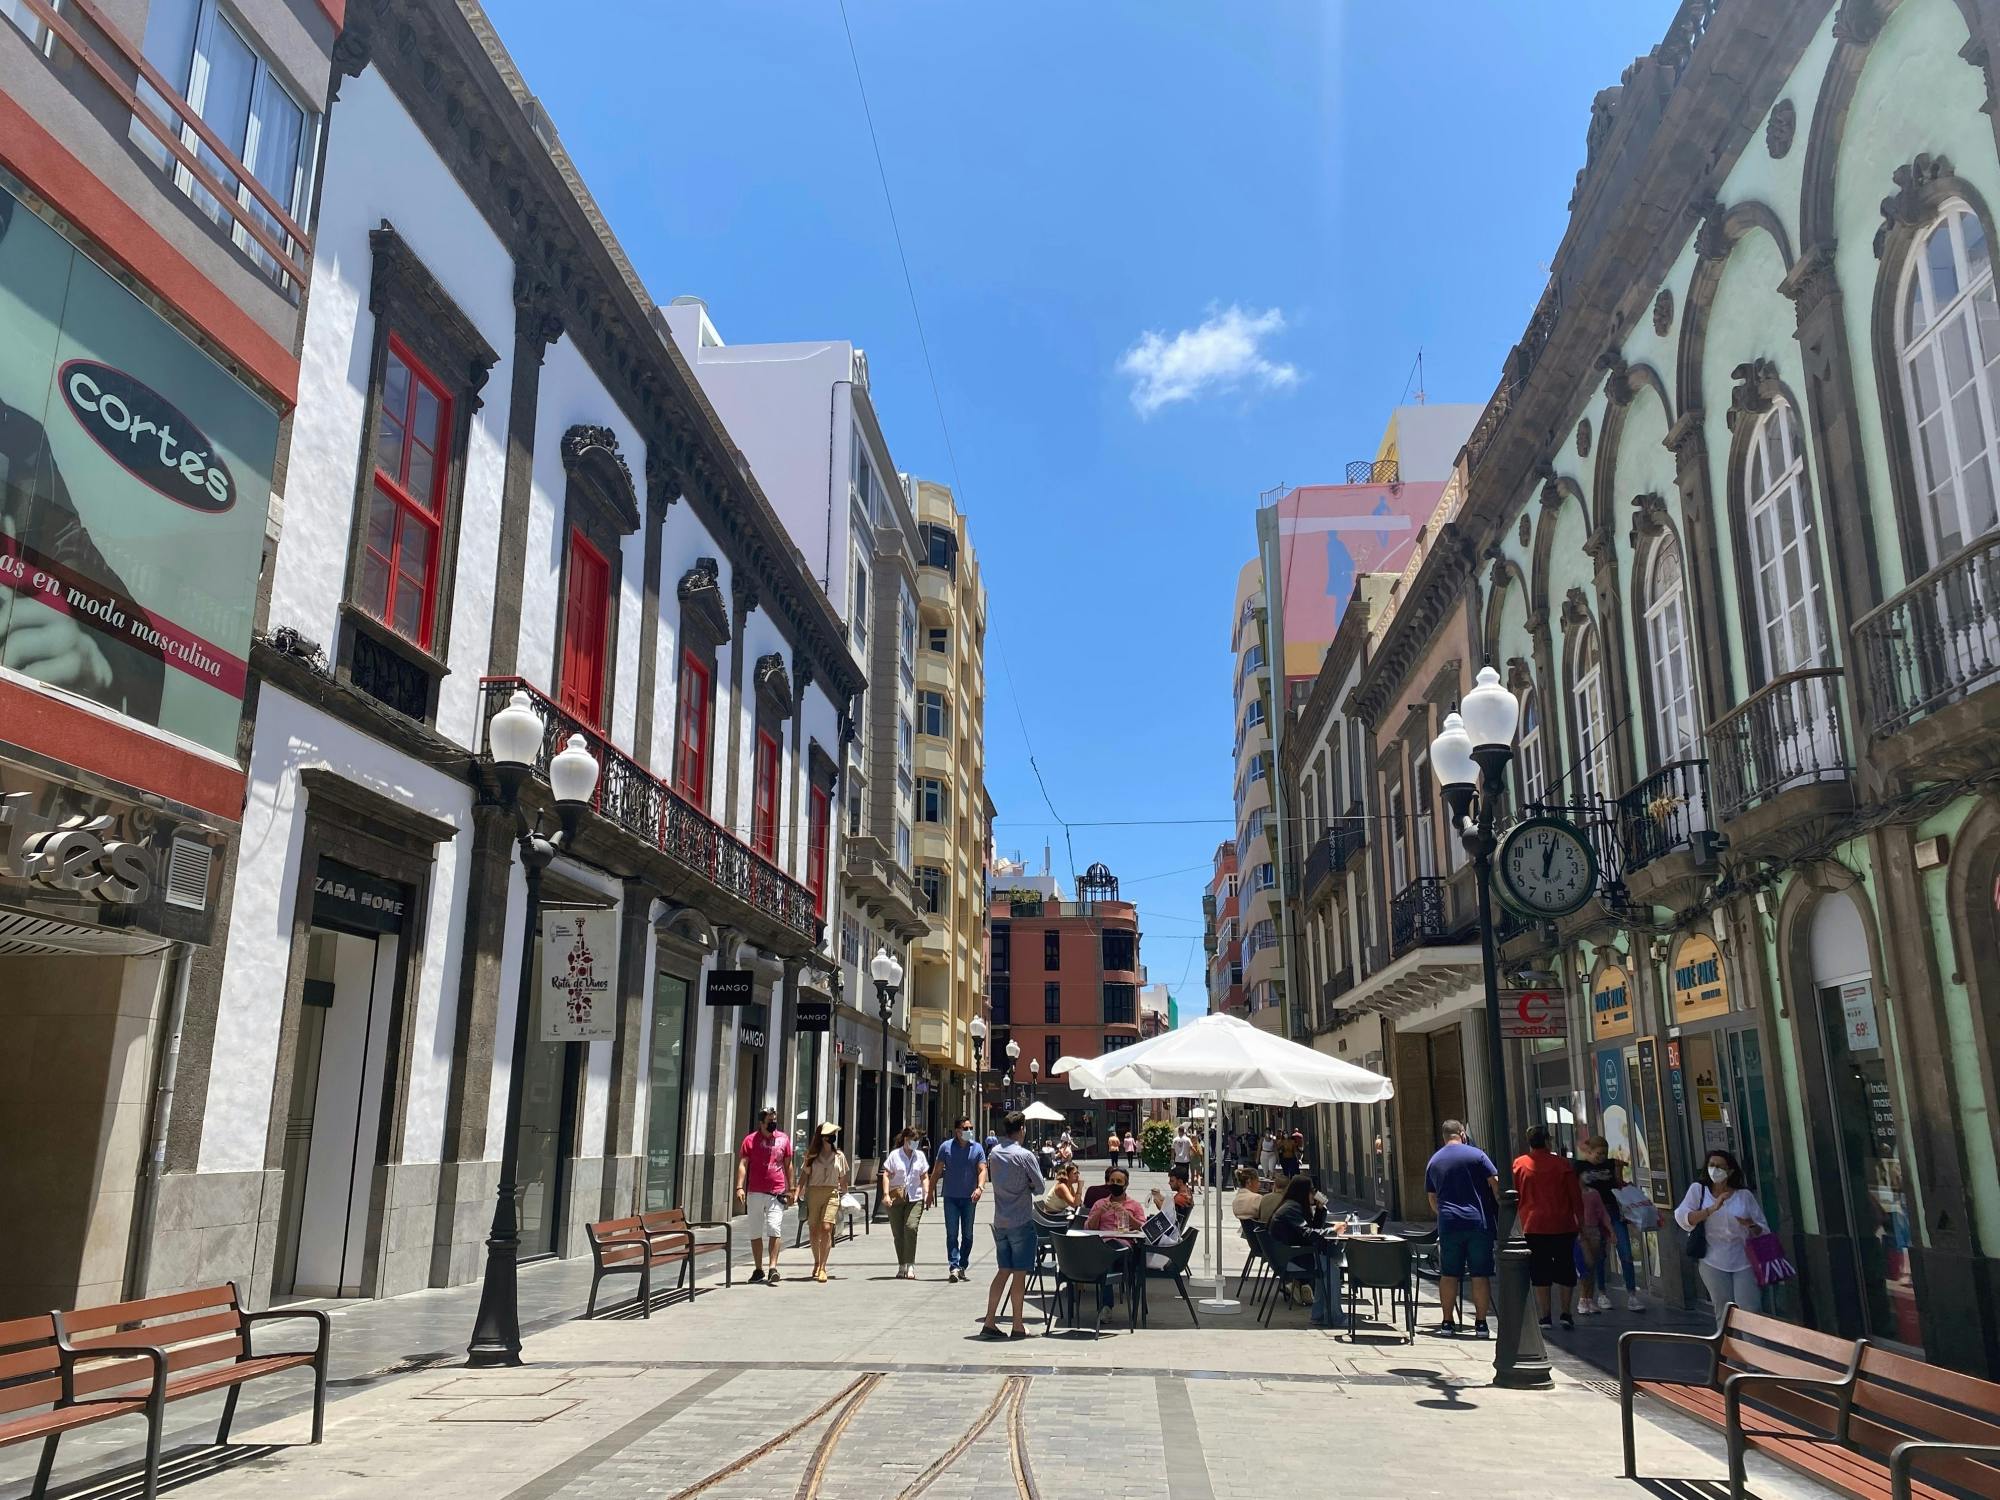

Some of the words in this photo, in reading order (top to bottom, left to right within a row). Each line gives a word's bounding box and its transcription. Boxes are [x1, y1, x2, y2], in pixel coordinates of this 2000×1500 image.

[70, 373, 228, 501] cortés
[33, 571, 60, 597] en
[67, 586, 124, 629] moda
[130, 619, 221, 677] masculina
[1525, 838, 1532, 849] 11
[1538, 832, 1549, 845] 12
[1514, 846, 1524, 858] 10
[1566, 847, 1574, 860] 2
[1513, 860, 1521, 872] 9
[1571, 861, 1578, 875] 3
[1517, 875, 1525, 888] 8
[1567, 877, 1576, 890] 4
[314, 876, 356, 902] ZARA
[360, 891, 405, 916] HOME
[1528, 886, 1537, 898] 7
[1544, 890, 1552, 904] 6
[1557, 888, 1565, 901] 5
[552, 976, 571, 990] Ruta
[710, 984, 749, 992] MANGO
[1518, 992, 1550, 1024] C
[740, 1027, 765, 1048] MANGO
[1005, 1101, 1012, 1110] P
